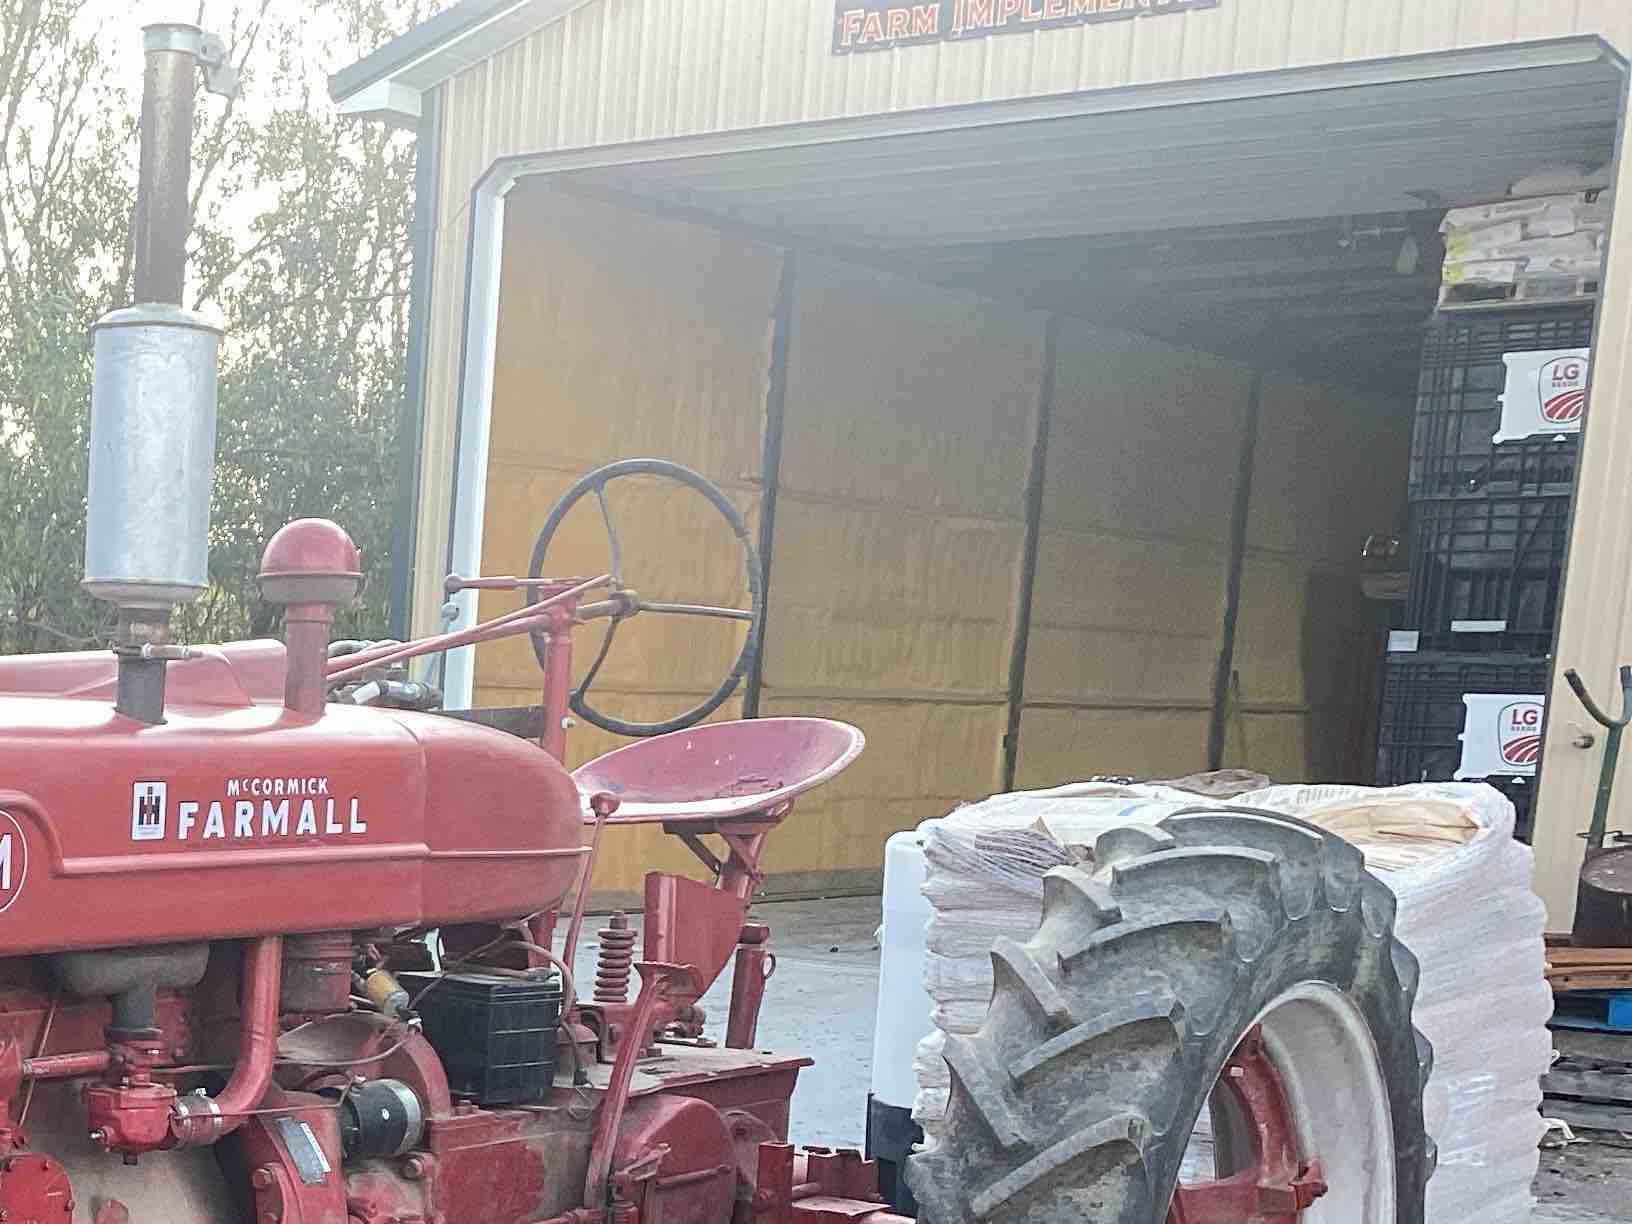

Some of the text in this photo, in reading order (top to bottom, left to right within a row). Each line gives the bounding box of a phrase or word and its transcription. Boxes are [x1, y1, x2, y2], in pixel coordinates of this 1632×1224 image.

[841, 7, 941, 46] FARM
[1552, 364, 1579, 380] LG
[1511, 709, 1537, 725] LG
[178, 798, 367, 840] FARMALL
